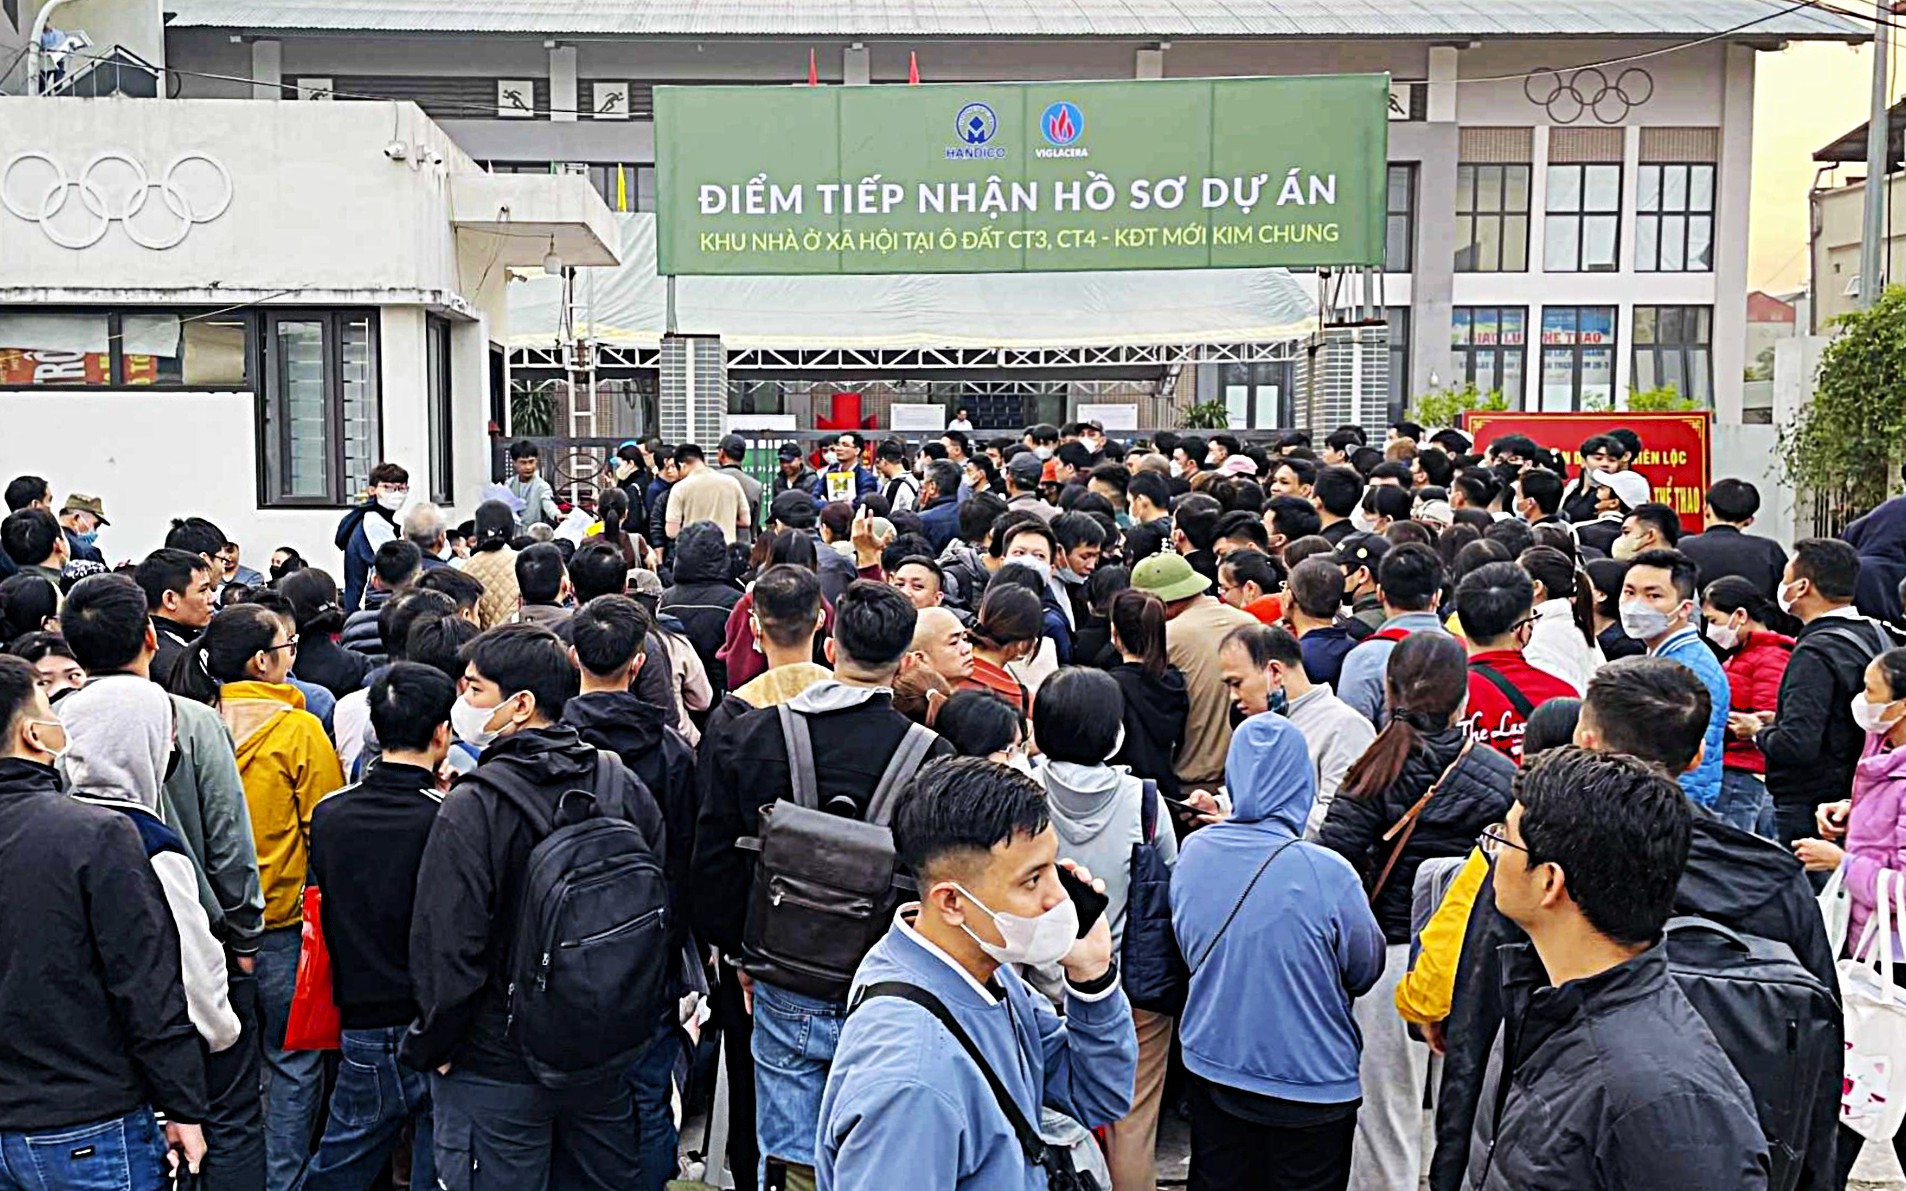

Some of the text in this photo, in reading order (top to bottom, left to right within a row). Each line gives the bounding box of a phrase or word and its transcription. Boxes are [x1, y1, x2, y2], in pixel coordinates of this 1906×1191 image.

[945, 147, 1006, 159] HANDICO
[1035, 149, 1088, 158] VIGLACERA
[698, 168, 1335, 218] ĐIỂM TIẾP NHẬN HỒ SƠ DỰ ÁN
[700, 232, 746, 251] KHU
[752, 229, 800, 251] NHÀ
[803, 228, 822, 251] Ở
[826, 229, 855, 251] XÃ
[859, 228, 898, 254] HỘI
[902, 231, 934, 254] TẠI
[939, 228, 957, 250] Ô
[961, 226, 1004, 250] ĐẤT
[1008, 230, 1052, 250] CT3,
[1056, 230, 1097, 248] CT4
[1115, 228, 1159, 247] KĐT
[1162, 223, 1207, 246] MỚI
[1213, 226, 1252, 245] KIM
[1258, 224, 1339, 244] CHUNG
[1663, 448, 1687, 468] LỘC
[1674, 486, 1701, 514] THAO
[1456, 711, 1488, 741] The
